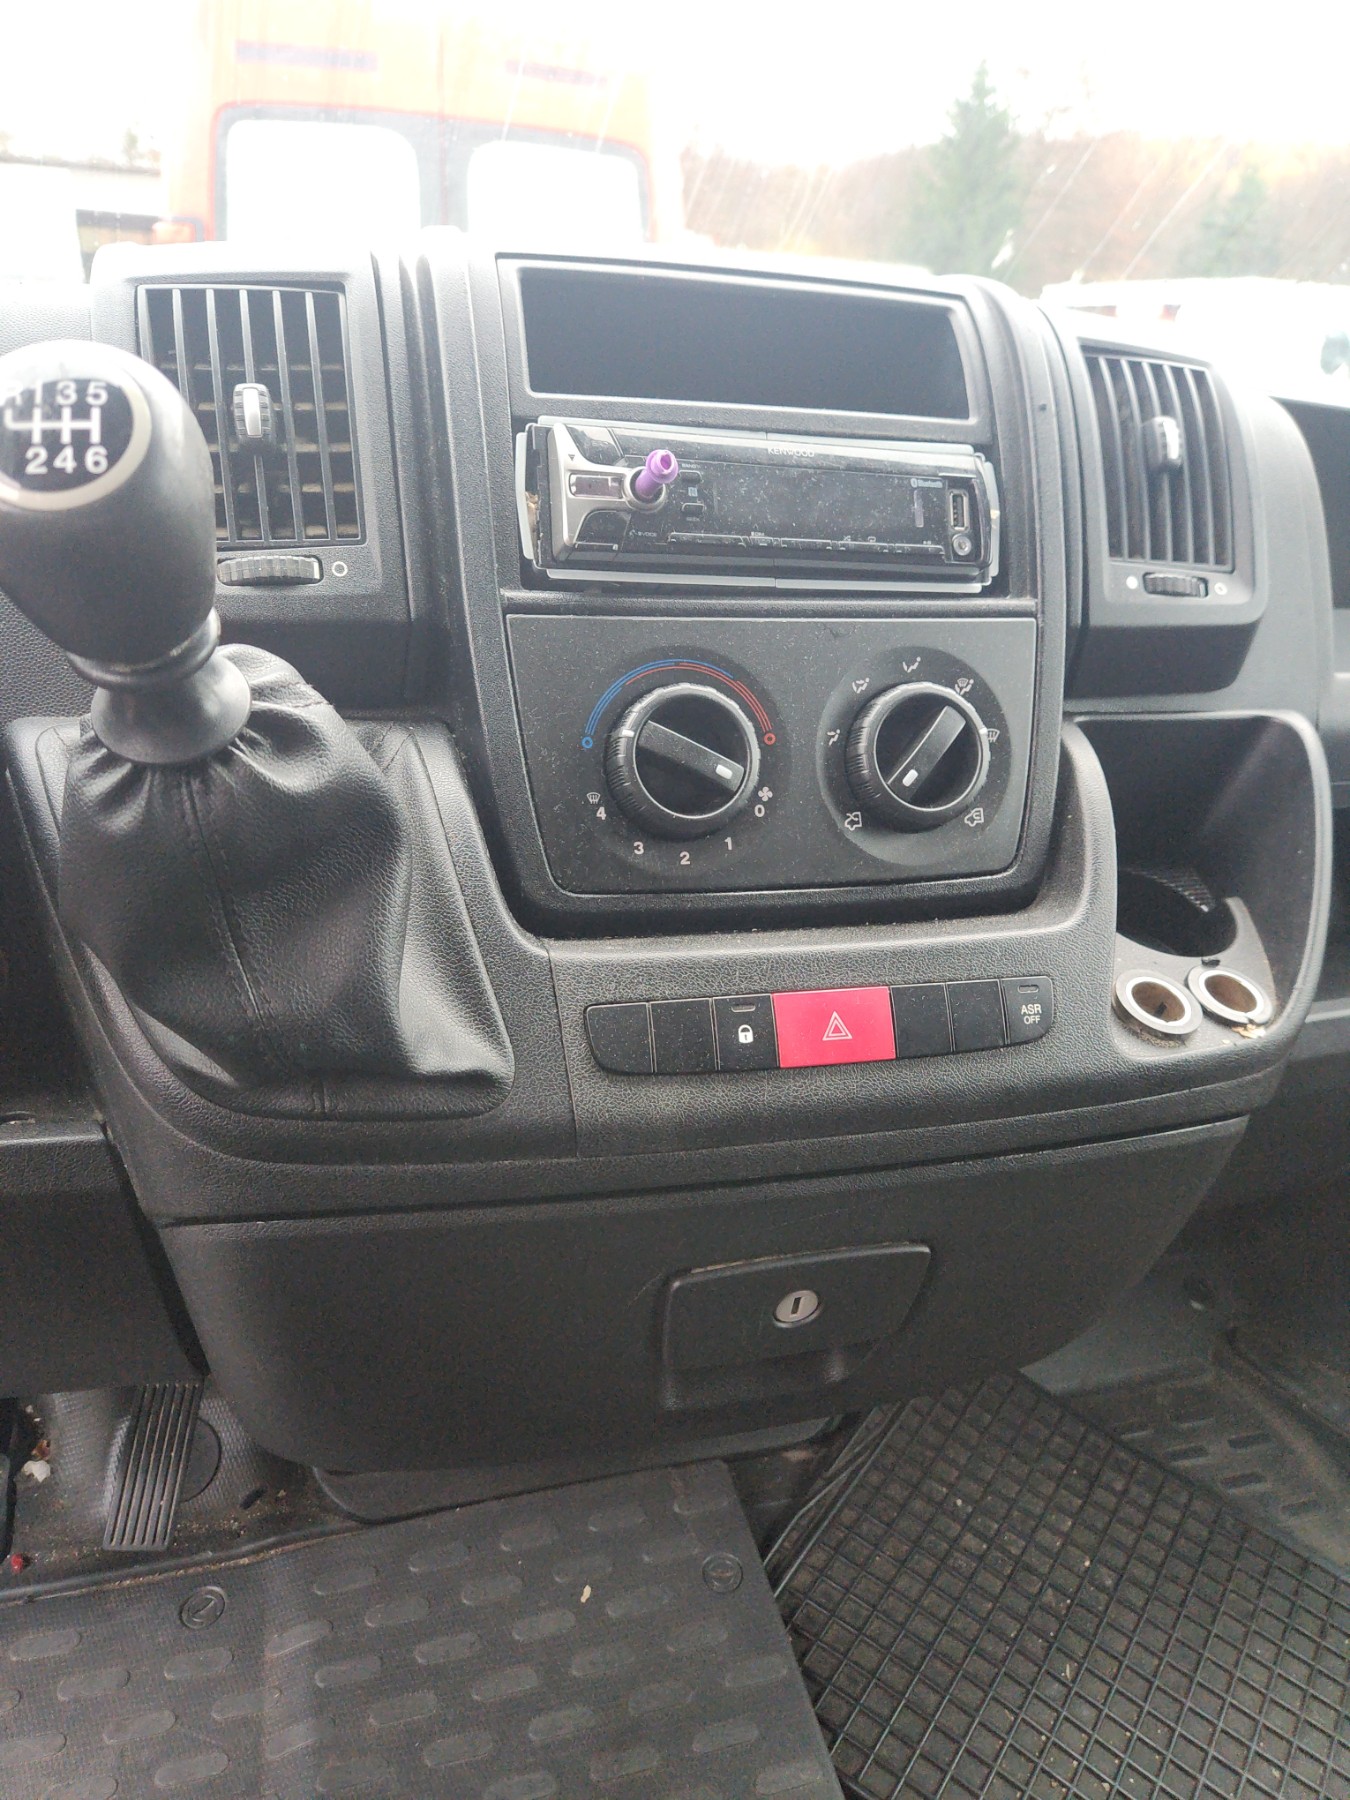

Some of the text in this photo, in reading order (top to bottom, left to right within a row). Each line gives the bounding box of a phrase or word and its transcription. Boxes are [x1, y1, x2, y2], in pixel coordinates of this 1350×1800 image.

[56, 380, 78, 406] 3
[85, 381, 109, 406] 5
[767, 447, 815, 458] KENWOOD
[24, 445, 109, 475] 2 4 6
[596, 806, 607, 820] 4
[754, 804, 765, 818] 0
[633, 842, 644, 855] 3
[724, 836, 733, 850] 1
[679, 851, 691, 865] 2
[1021, 1004, 1042, 1015] ASR
[1024, 1015, 1041, 1024] OFF
